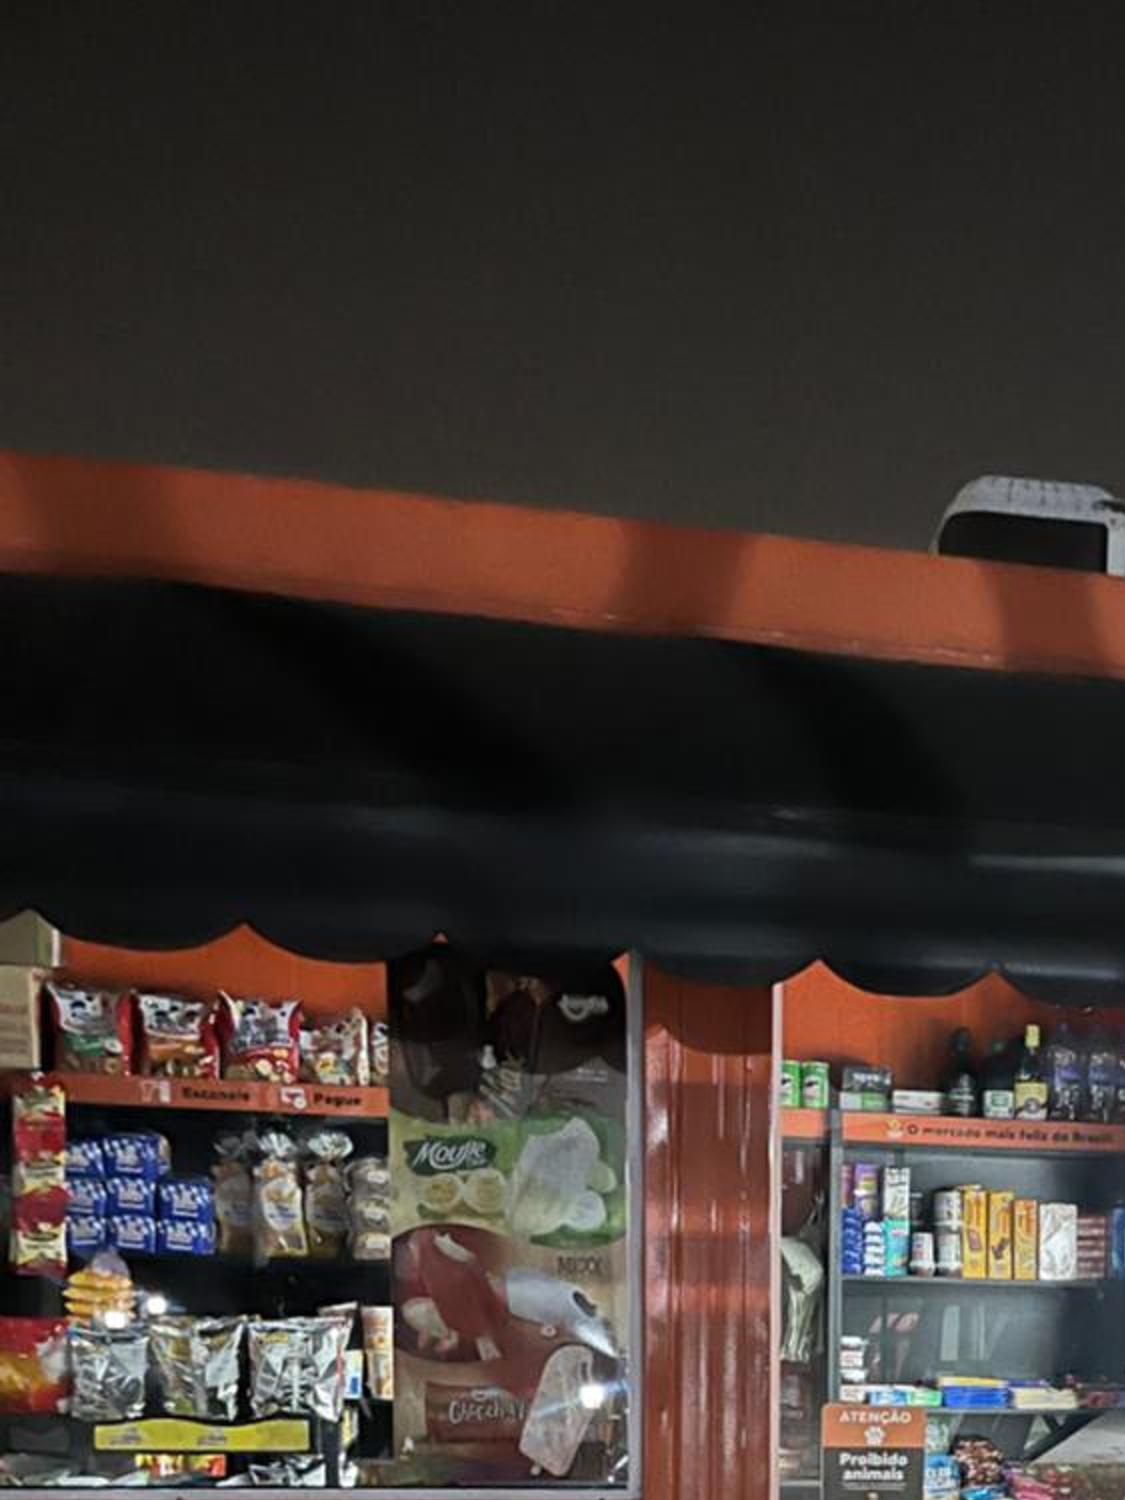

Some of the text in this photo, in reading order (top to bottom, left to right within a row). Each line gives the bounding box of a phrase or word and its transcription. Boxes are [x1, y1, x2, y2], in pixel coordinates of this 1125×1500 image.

[839, 1408, 912, 1425] ATENÇÃO
[839, 1451, 908, 1467] Proibido
[843, 1466, 904, 1480] animais
